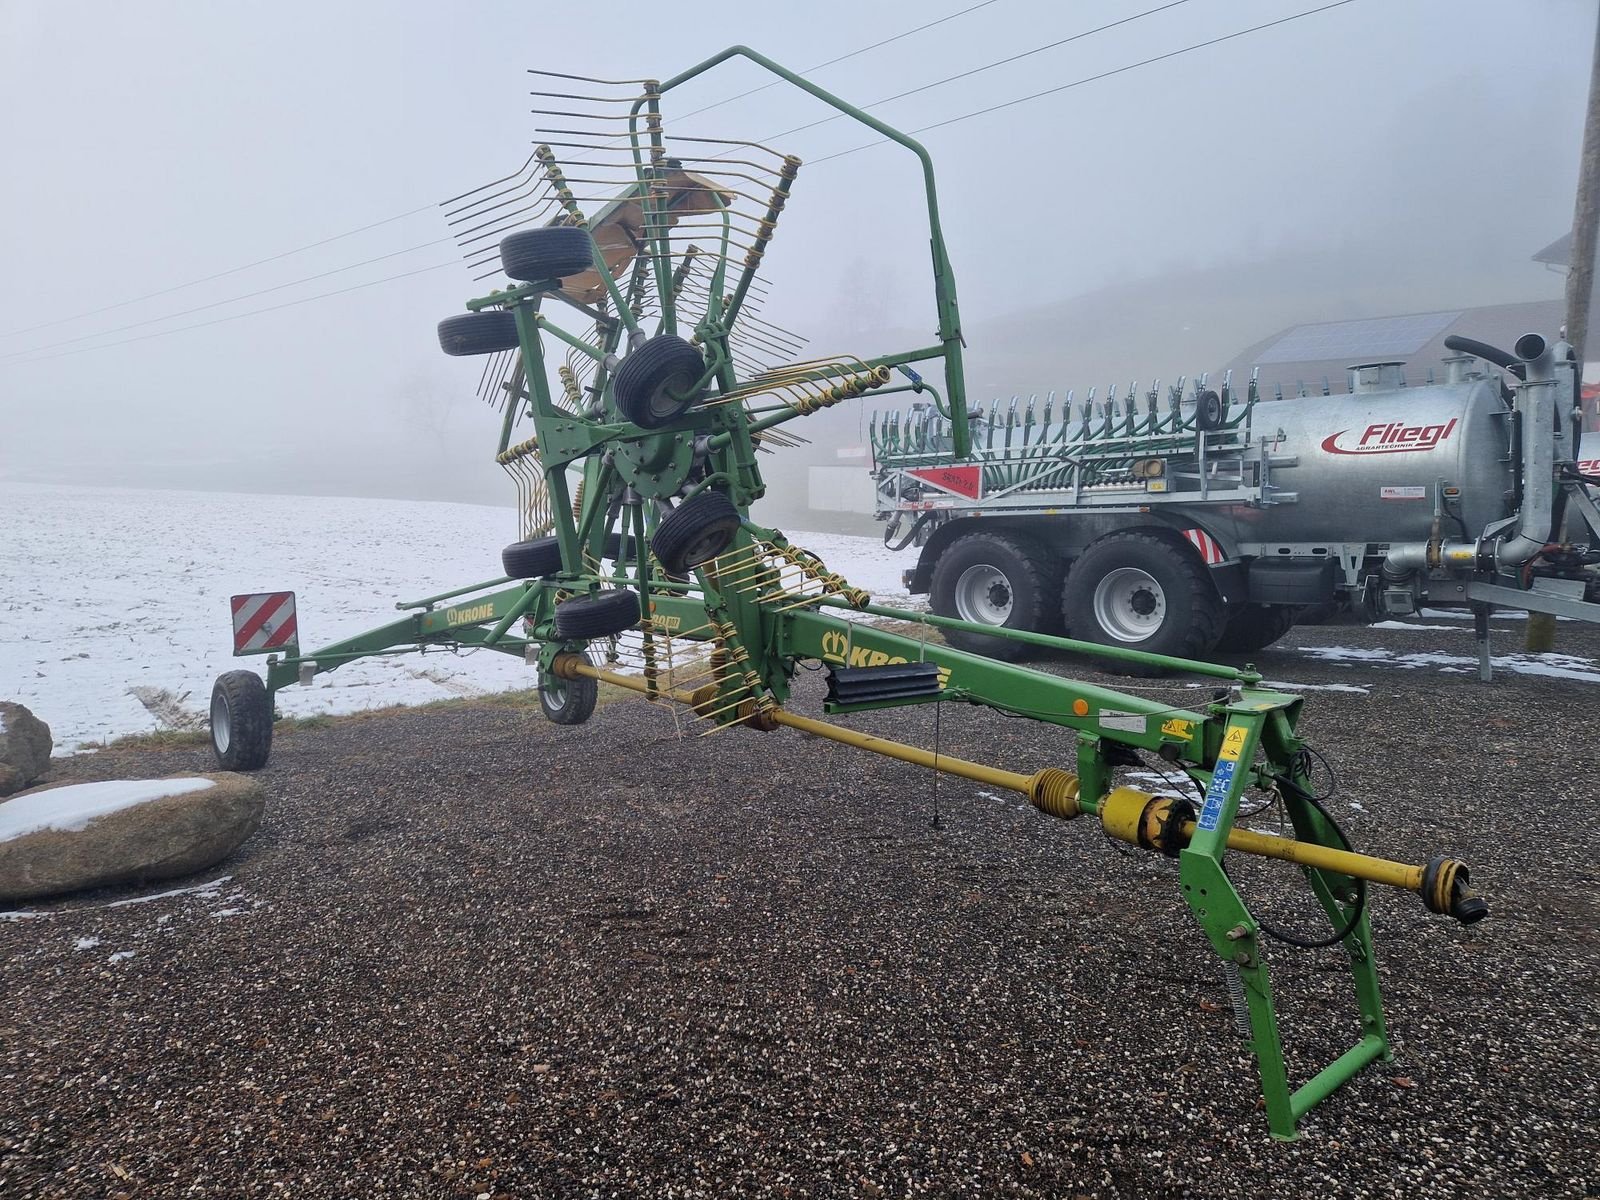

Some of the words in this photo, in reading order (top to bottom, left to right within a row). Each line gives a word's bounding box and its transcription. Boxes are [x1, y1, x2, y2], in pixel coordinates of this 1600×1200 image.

[1359, 418, 1458, 447] Fliegl
[1355, 443, 1414, 451] AGRARTECHNIK
[458, 603, 494, 625] KRONE
[850, 646, 952, 690] KRE
